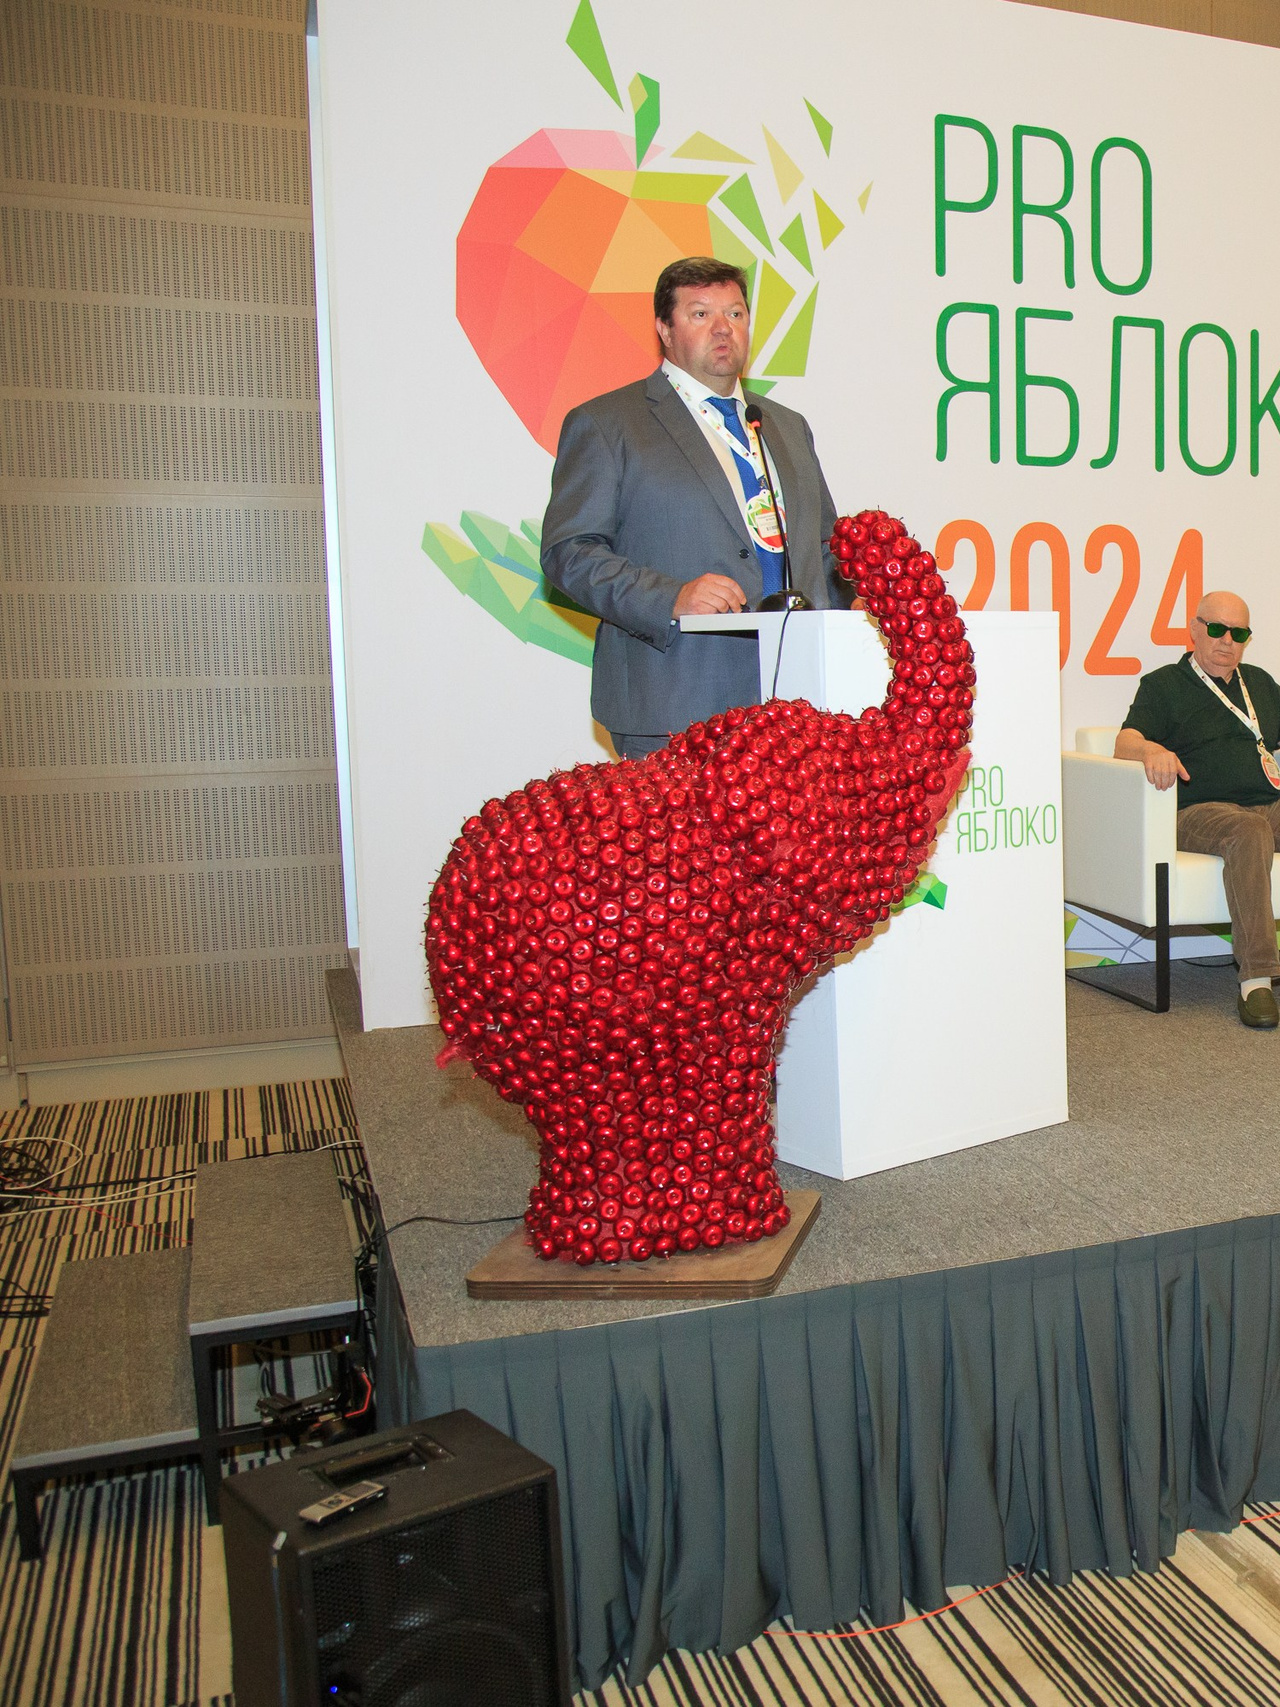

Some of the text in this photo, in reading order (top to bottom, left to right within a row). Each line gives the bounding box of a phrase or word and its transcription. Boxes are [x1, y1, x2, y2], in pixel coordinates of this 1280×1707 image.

[935, 113, 1153, 295] PRO
[935, 519, 1204, 676] 2024
[956, 765, 1004, 810] PRO
[957, 804, 1057, 854] ЯБЛОКО
